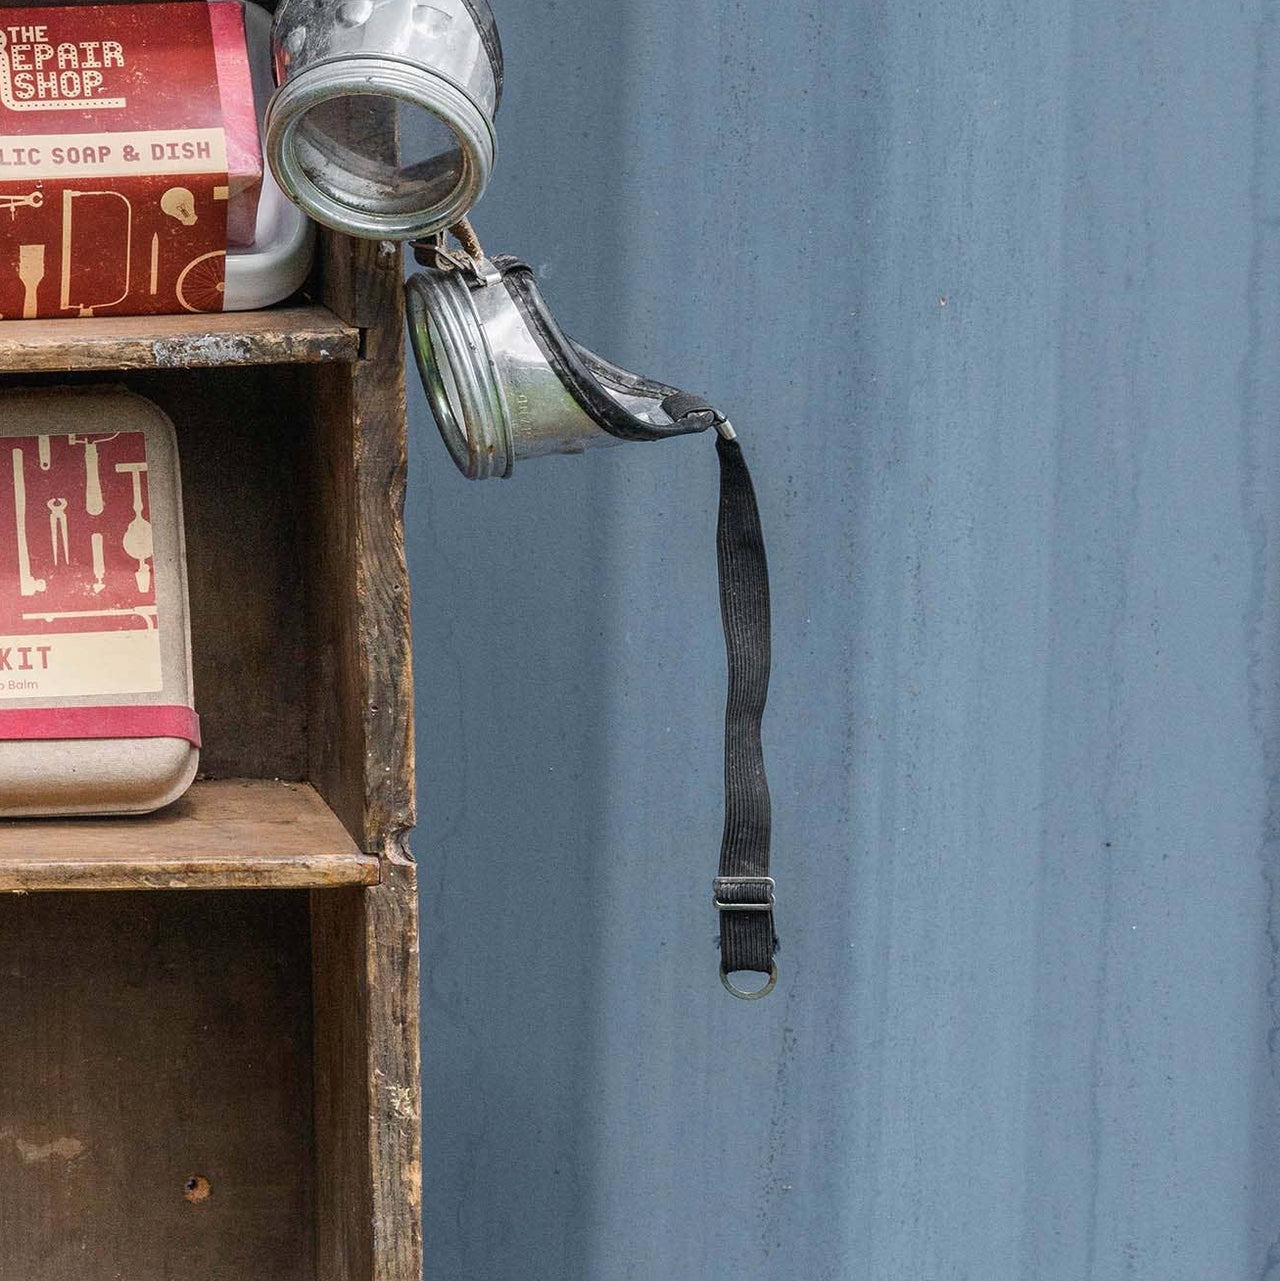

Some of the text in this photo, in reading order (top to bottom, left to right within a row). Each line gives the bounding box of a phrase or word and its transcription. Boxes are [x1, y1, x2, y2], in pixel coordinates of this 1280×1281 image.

[8, 26, 48, 43] THE
[13, 70, 103, 99] SHOP
[52, 146, 111, 166] SOAP
[123, 144, 140, 162] &
[151, 141, 211, 161] DISH
[8, 680, 38, 690] Balm
